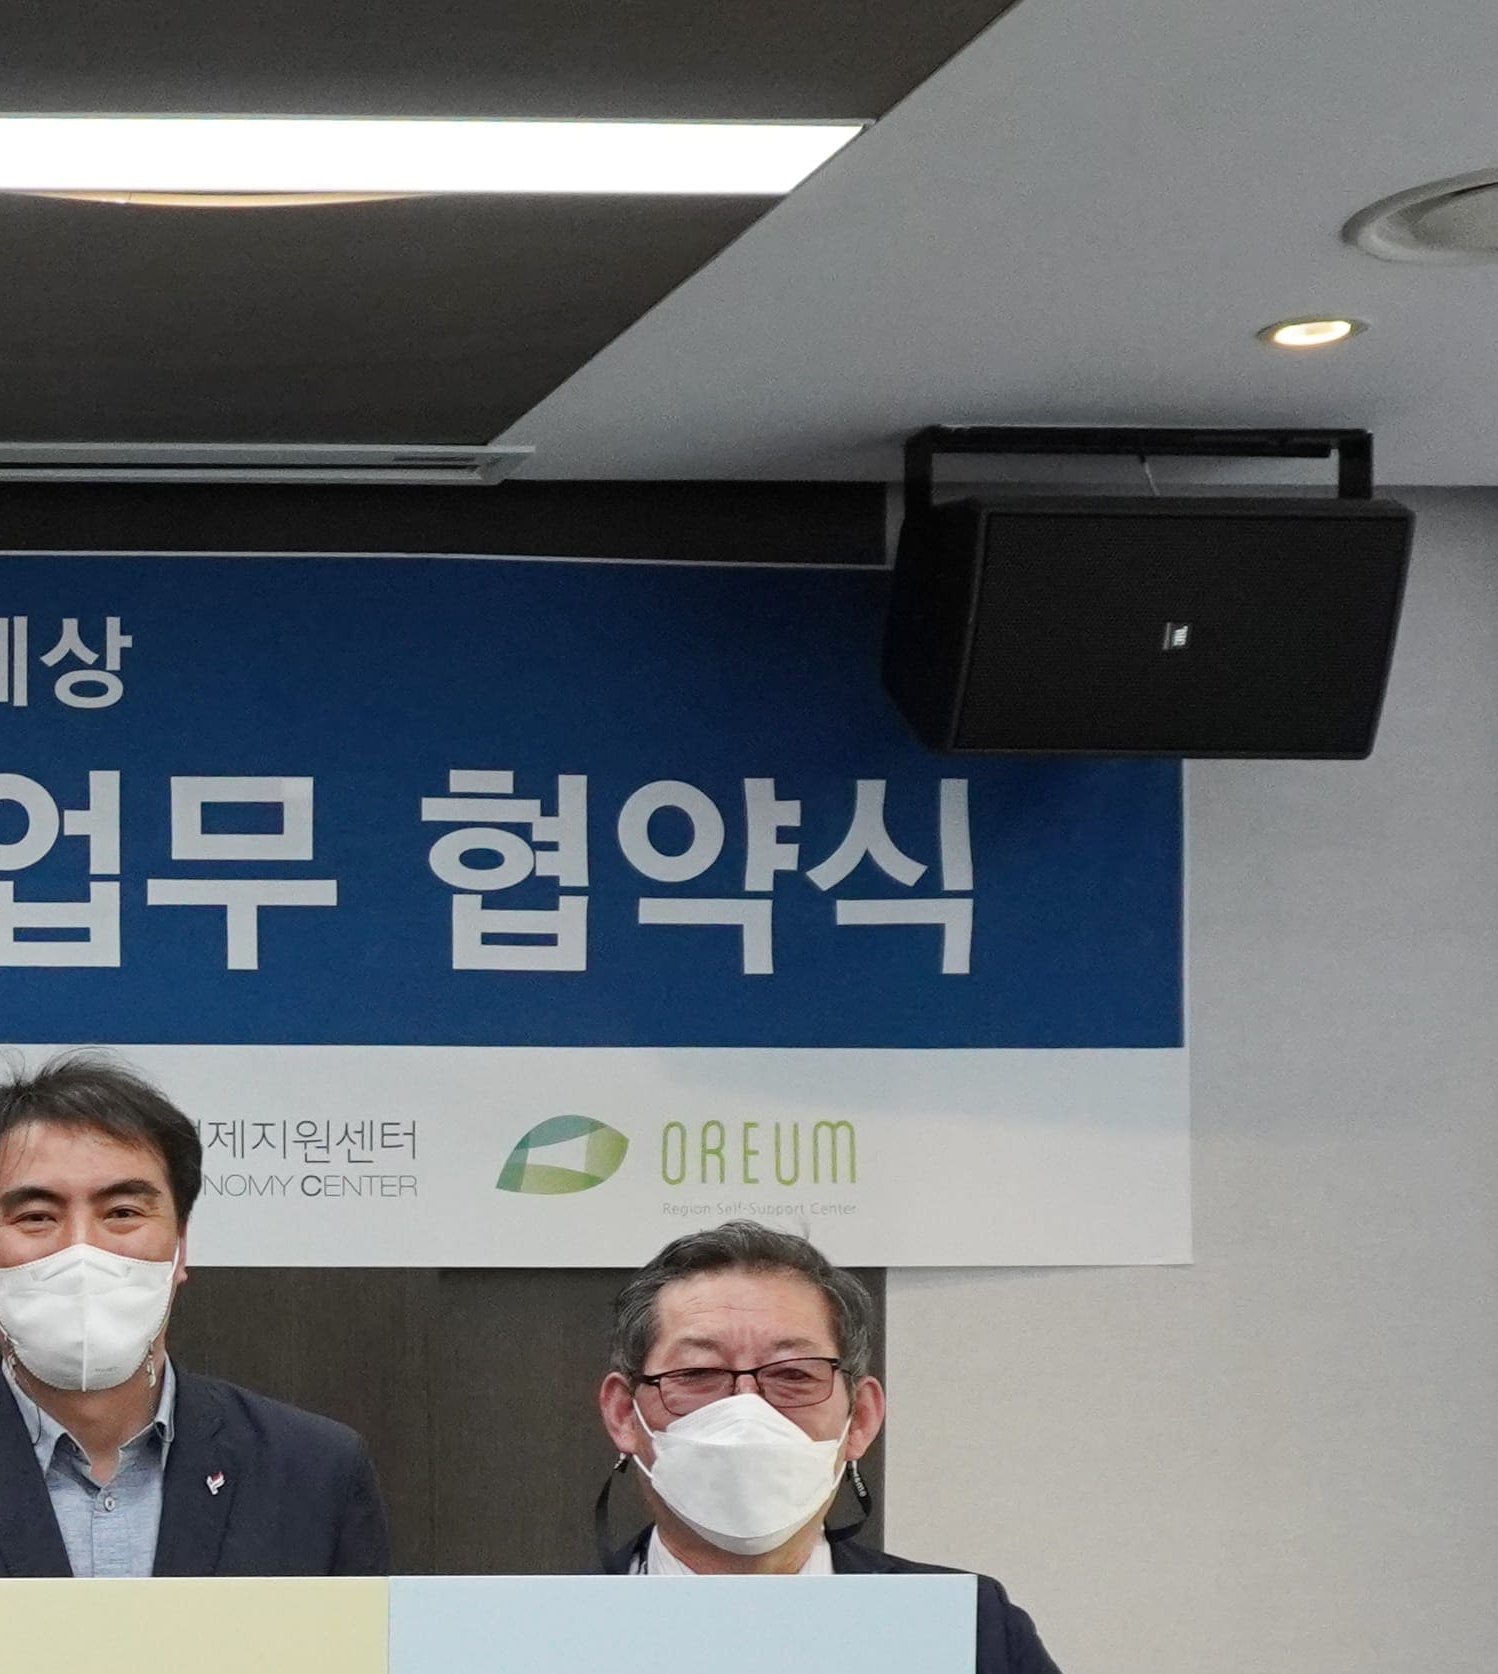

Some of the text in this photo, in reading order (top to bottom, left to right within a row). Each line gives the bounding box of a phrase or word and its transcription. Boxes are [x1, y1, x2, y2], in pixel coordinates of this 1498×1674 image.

[421, 769, 975, 977] 협약식
[194, 1119, 416, 1164] 제지원센터
[660, 1119, 858, 1186] OREUM
[202, 1173, 419, 1198] NOMY CENTER
